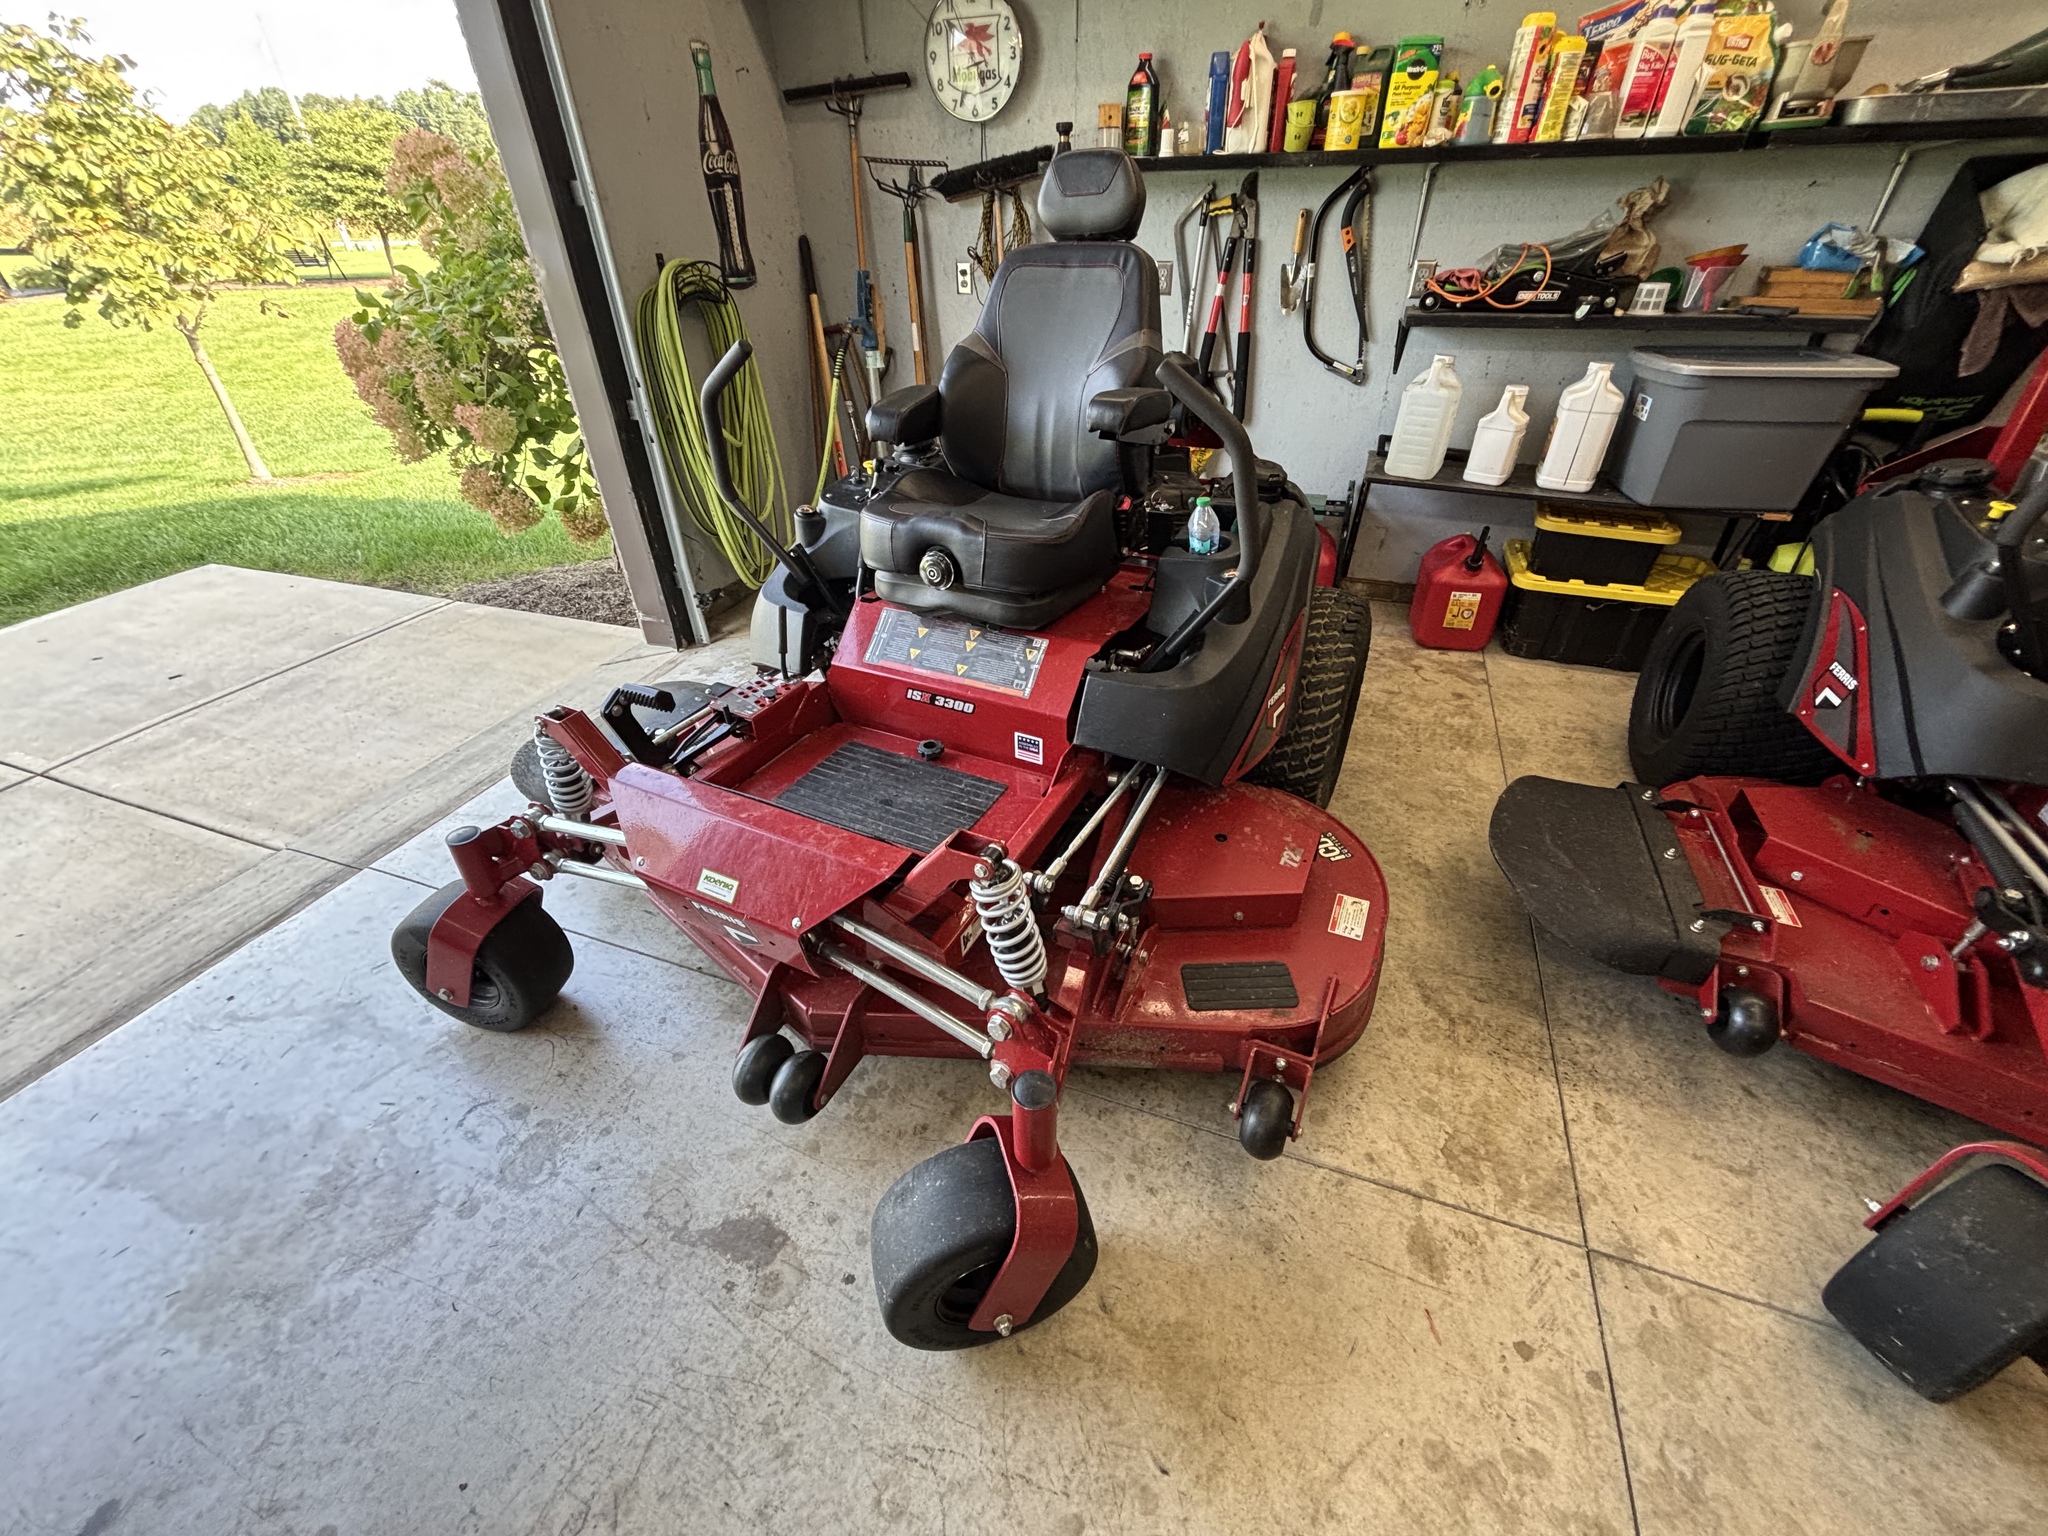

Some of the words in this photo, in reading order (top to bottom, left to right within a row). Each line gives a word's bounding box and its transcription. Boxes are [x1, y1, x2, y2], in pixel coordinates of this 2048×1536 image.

[932, 22, 942, 37] 10
[1004, 16, 1010, 31] 2
[930, 51, 937, 65] 9
[1010, 46, 1017, 60] 3
[937, 78, 944, 92] 8
[1004, 74, 1011, 89] 4
[952, 99, 958, 112] 7
[991, 97, 998, 110] 5
[972, 105, 979, 118] 6
[703, 150, 738, 175] Coca-Cola
[1829, 661, 1859, 690] FERRIS
[906, 688, 932, 704] ISX
[934, 695, 975, 714] 3300
[1267, 683, 1286, 709] FERRIS
